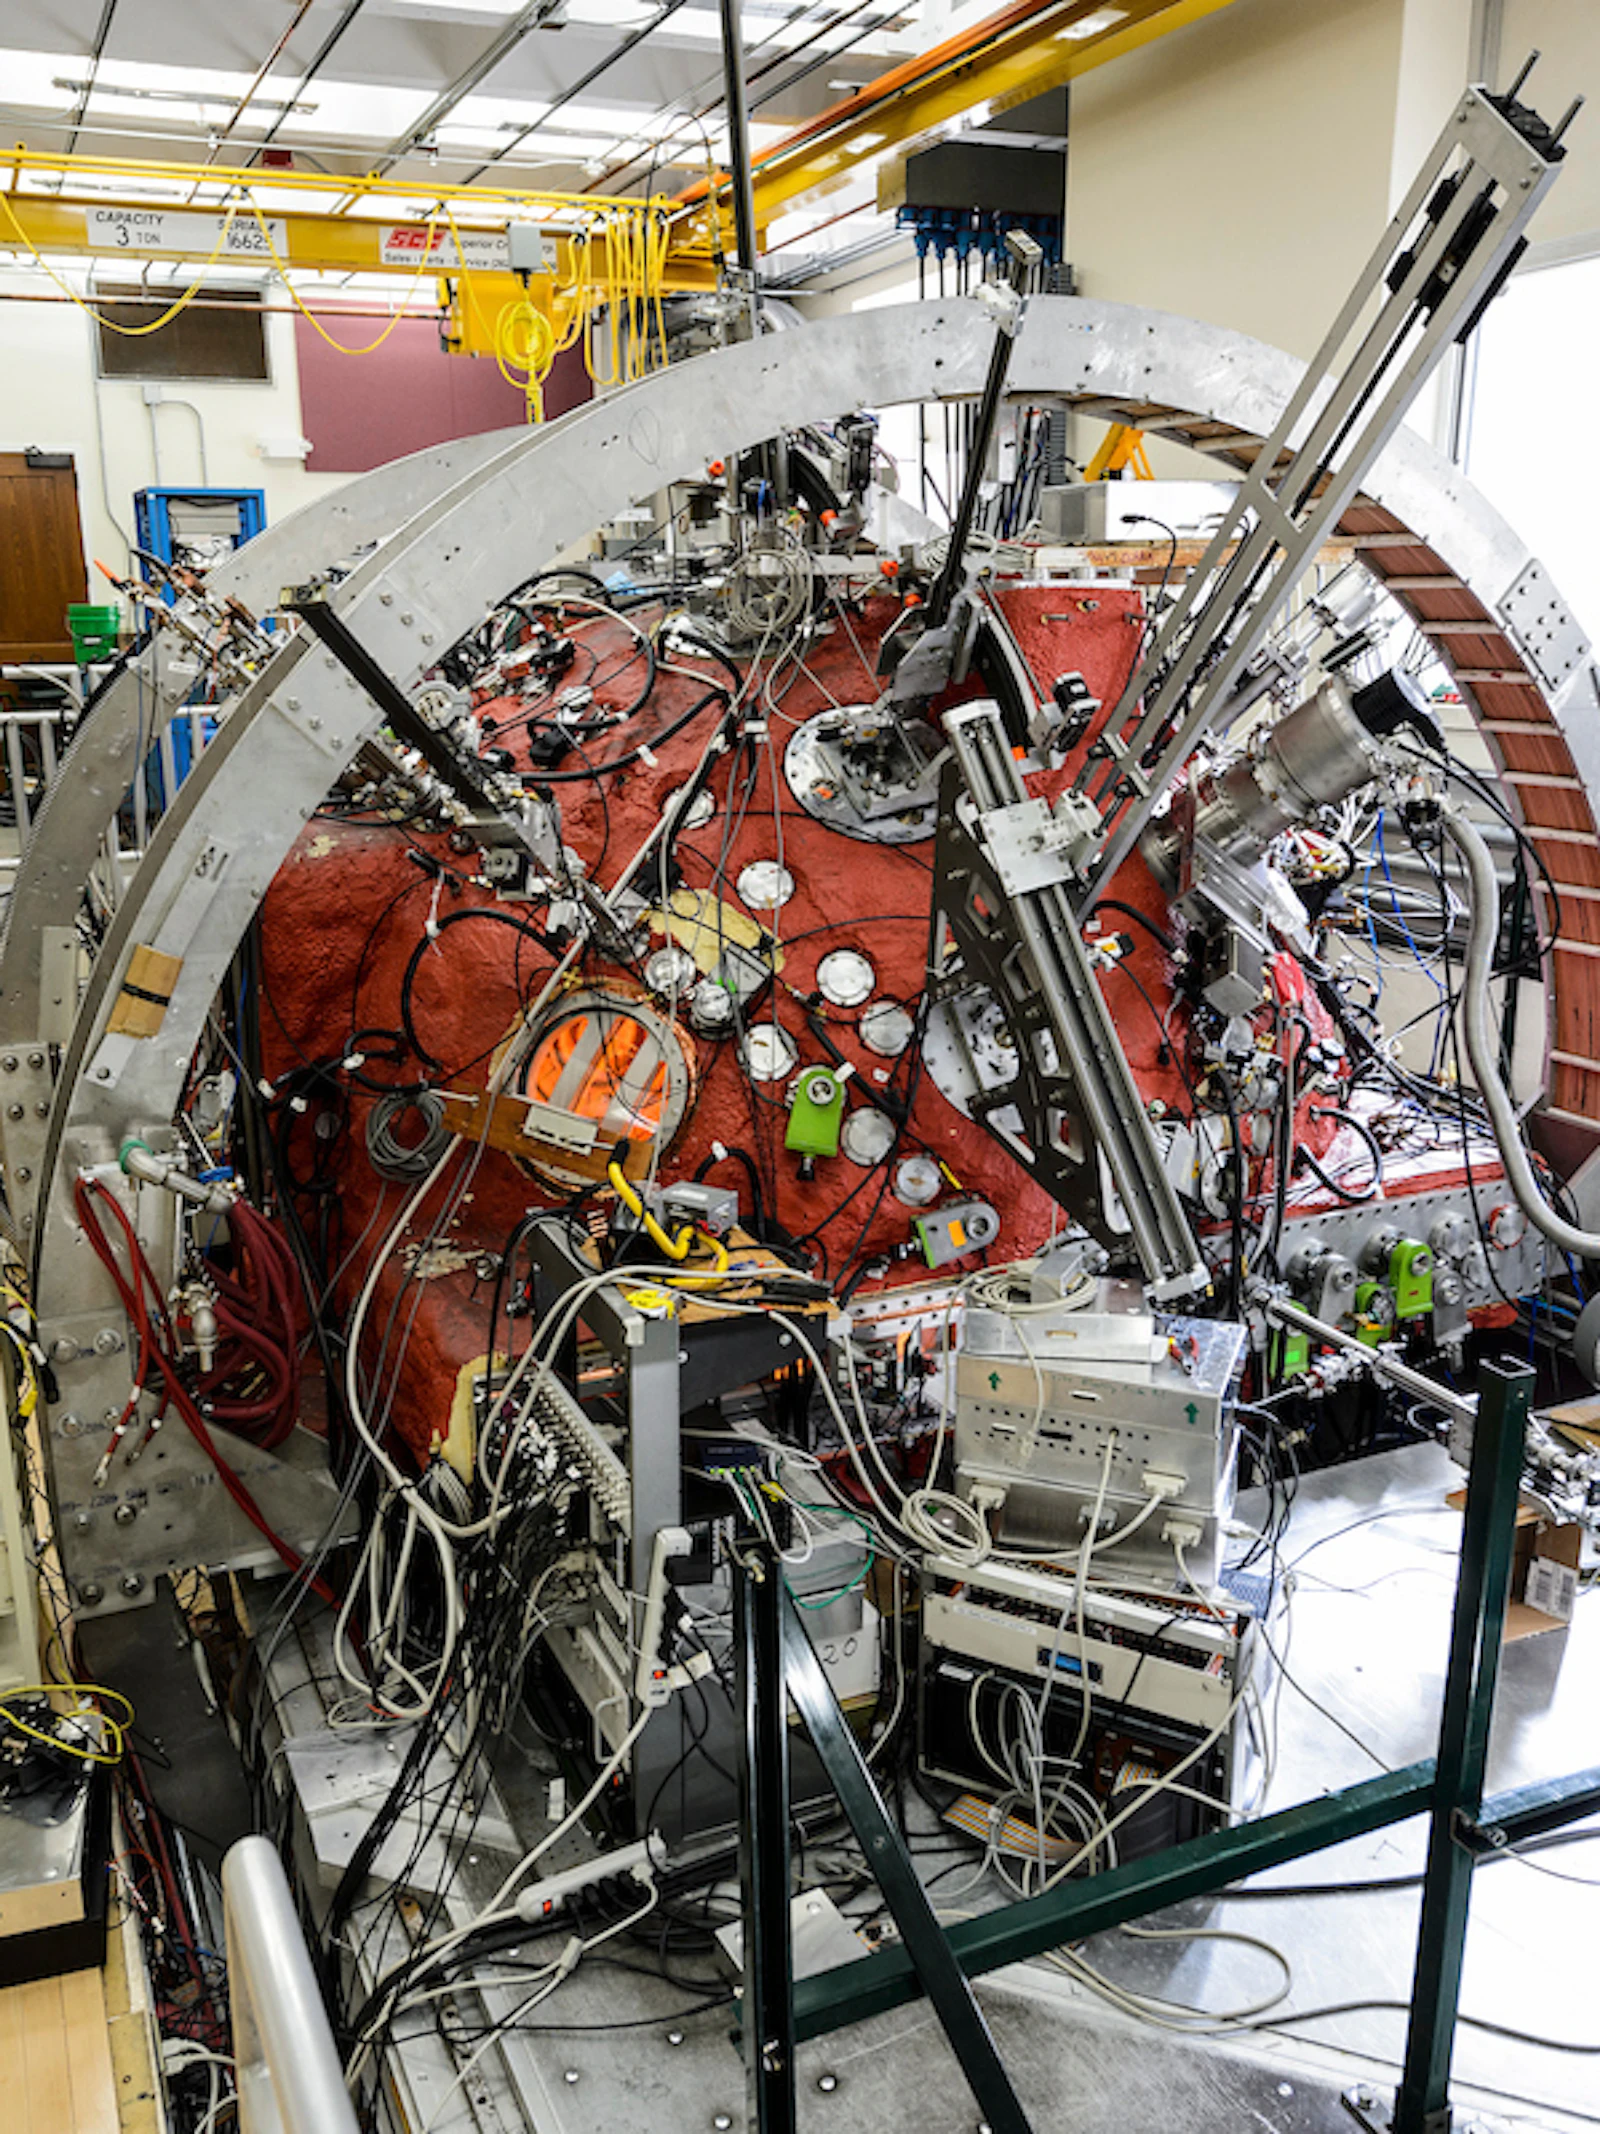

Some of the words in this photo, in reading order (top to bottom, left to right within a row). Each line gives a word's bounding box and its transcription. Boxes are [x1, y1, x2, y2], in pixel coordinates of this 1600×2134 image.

[95, 211, 164, 226] CAPACITY
[116, 224, 130, 247] 3
[136, 232, 161, 244] TON
[449, 237, 492, 249] Sperior
[454, 257, 488, 268] Srvice
